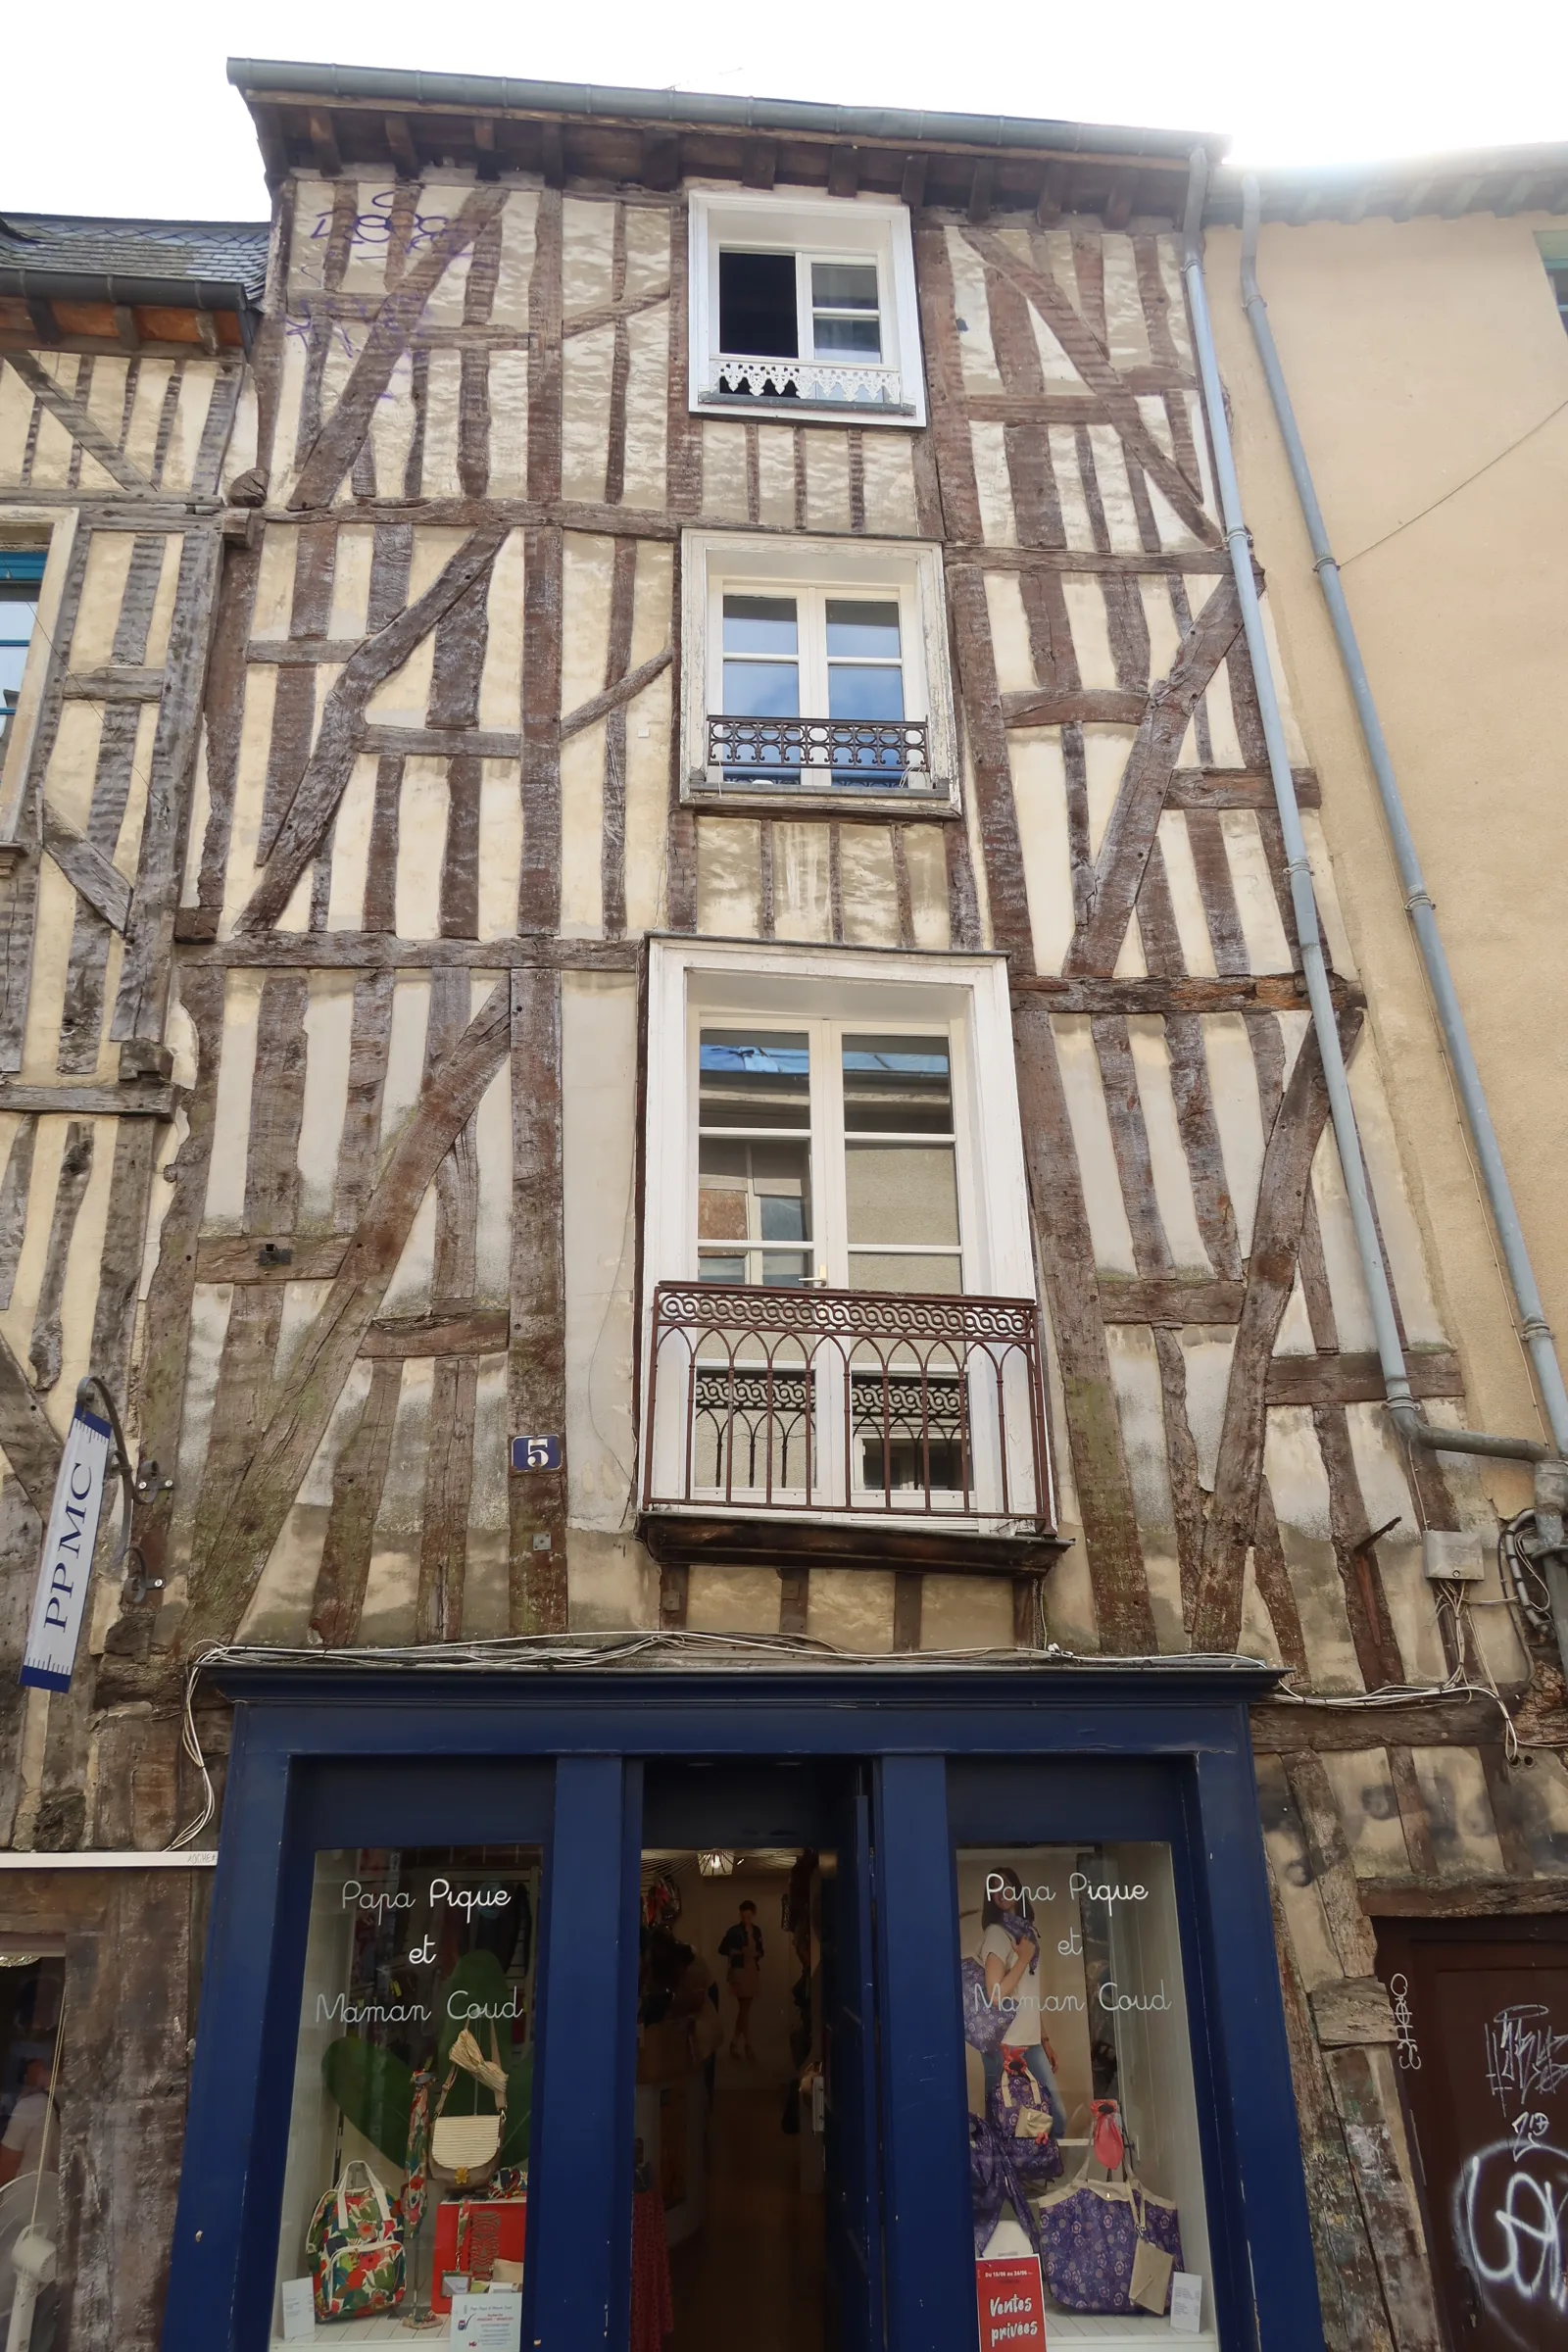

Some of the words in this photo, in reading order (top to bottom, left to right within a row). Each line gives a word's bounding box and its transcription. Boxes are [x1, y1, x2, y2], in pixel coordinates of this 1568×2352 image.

[527, 1439, 549, 1467] 5
[44, 1462, 92, 1633] PPMC
[342, 1880, 416, 1926] Papa
[429, 1878, 512, 1924] Pique
[986, 1873, 1056, 1918] Papa
[1069, 1872, 1150, 1917] Pique
[409, 1934, 437, 1964] et
[1057, 1927, 1083, 1955] et
[316, 1992, 432, 2023] Maman
[447, 1985, 523, 2020] Coud
[973, 1983, 1085, 2012] Maman
[1099, 1979, 1172, 2011] Coud
[990, 2293, 1032, 2317] Ventes
[991, 2321, 1038, 2347] privées
